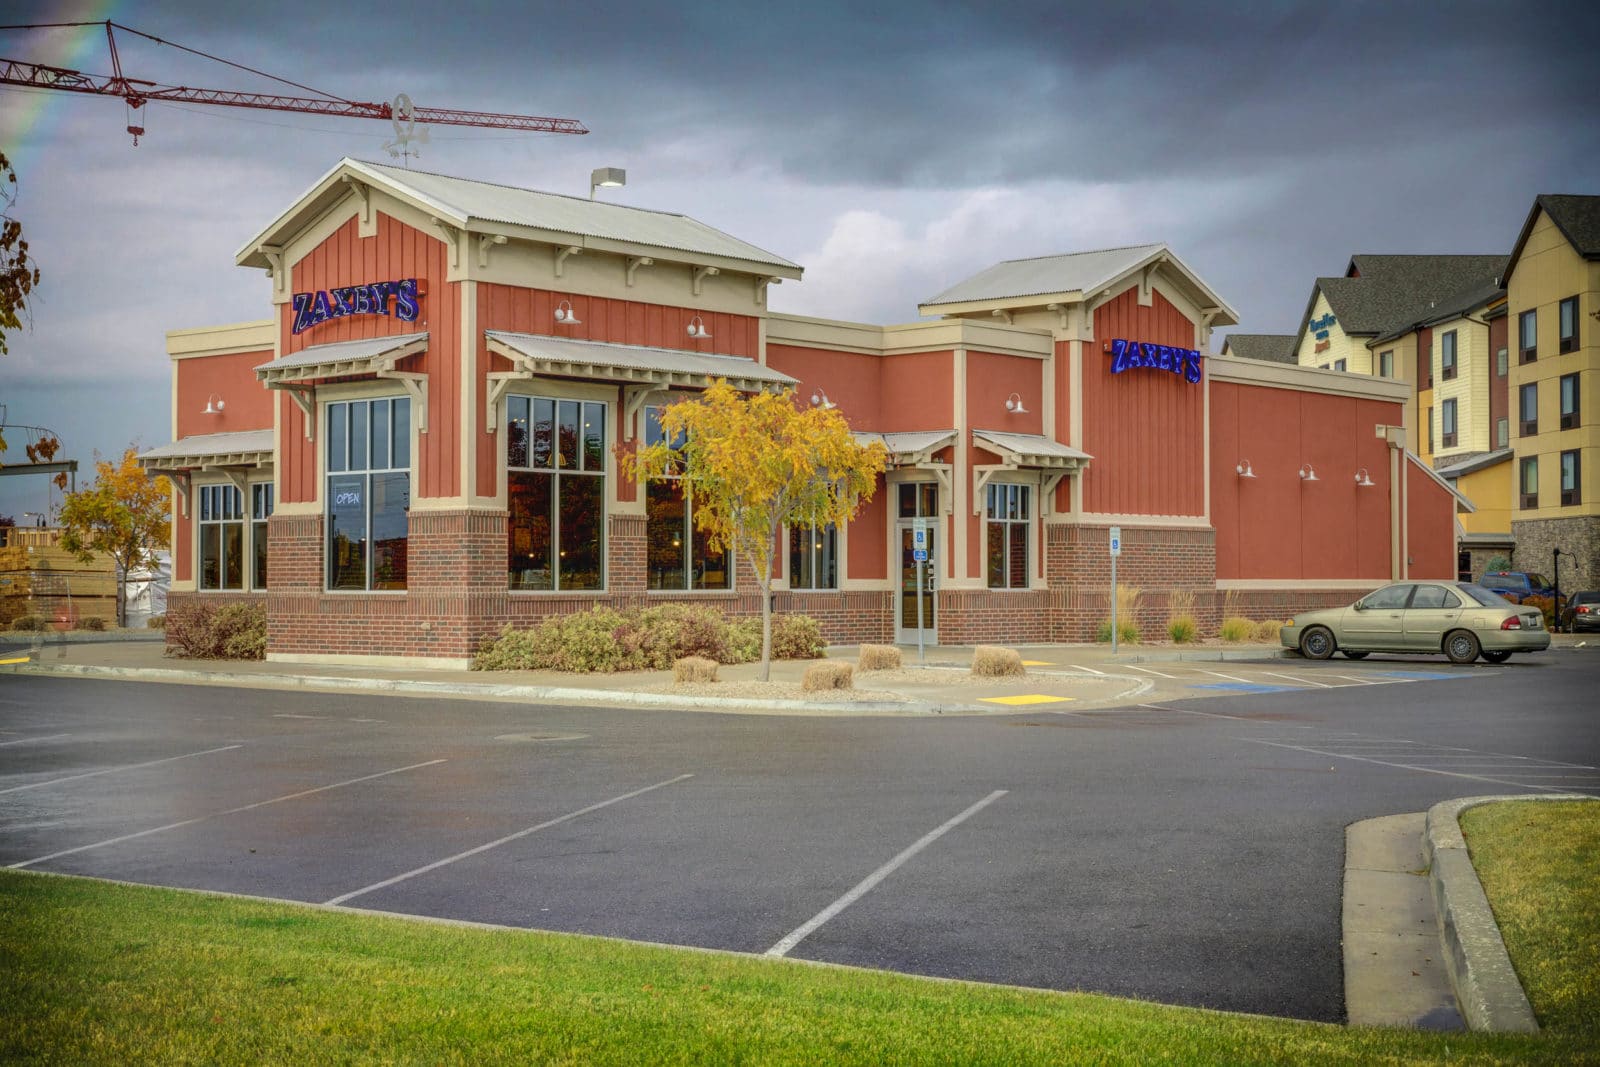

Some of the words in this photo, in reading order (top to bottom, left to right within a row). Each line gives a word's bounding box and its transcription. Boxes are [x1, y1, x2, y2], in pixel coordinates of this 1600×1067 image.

[292, 278, 419, 335] ZAXBY'S
[1110, 338, 1201, 385] ZAXBY'S
[336, 492, 360, 504] OPEN
